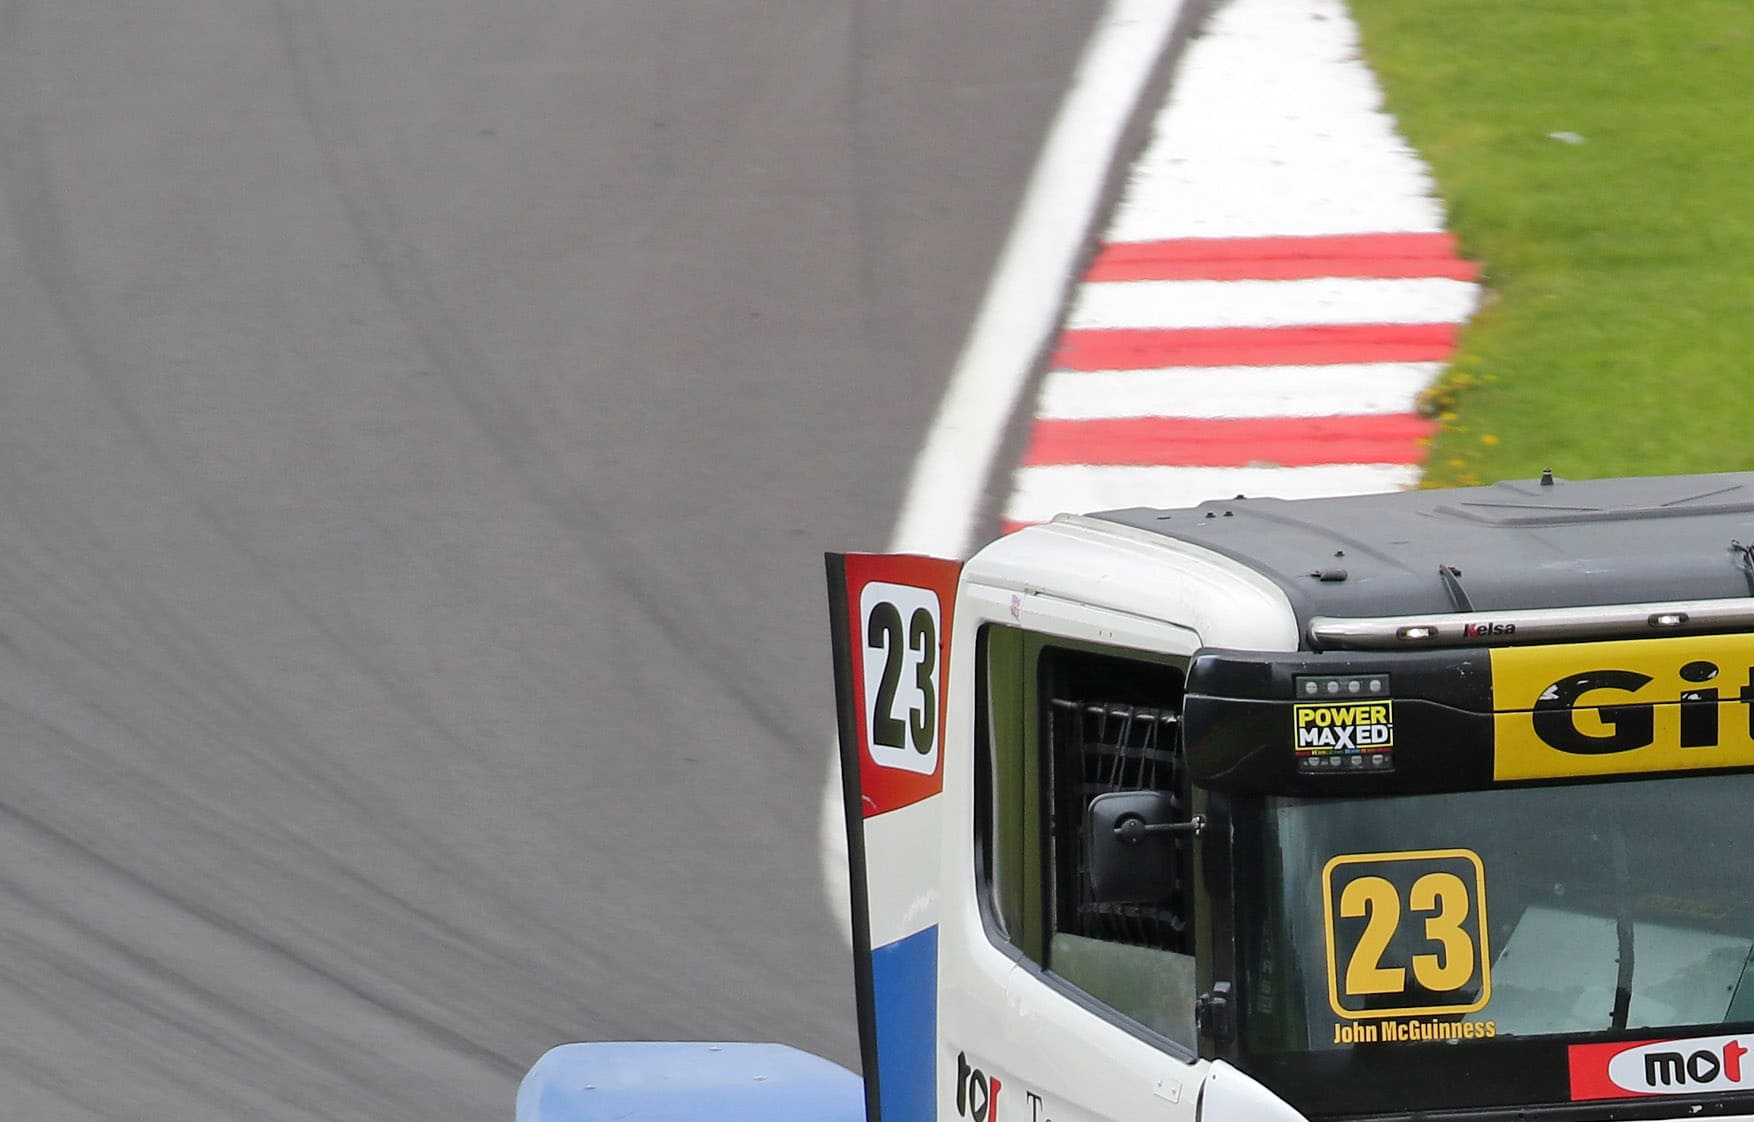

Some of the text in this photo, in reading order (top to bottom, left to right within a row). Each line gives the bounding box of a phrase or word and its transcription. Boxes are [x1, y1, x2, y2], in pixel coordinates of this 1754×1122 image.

[1463, 622, 1516, 638] Kelsa
[868, 601, 937, 755] 23
[1298, 706, 1387, 728] POWER
[1300, 725, 1388, 749] MAXED
[1340, 872, 1474, 995] 23
[1334, 1018, 1497, 1044] John McGuinness
